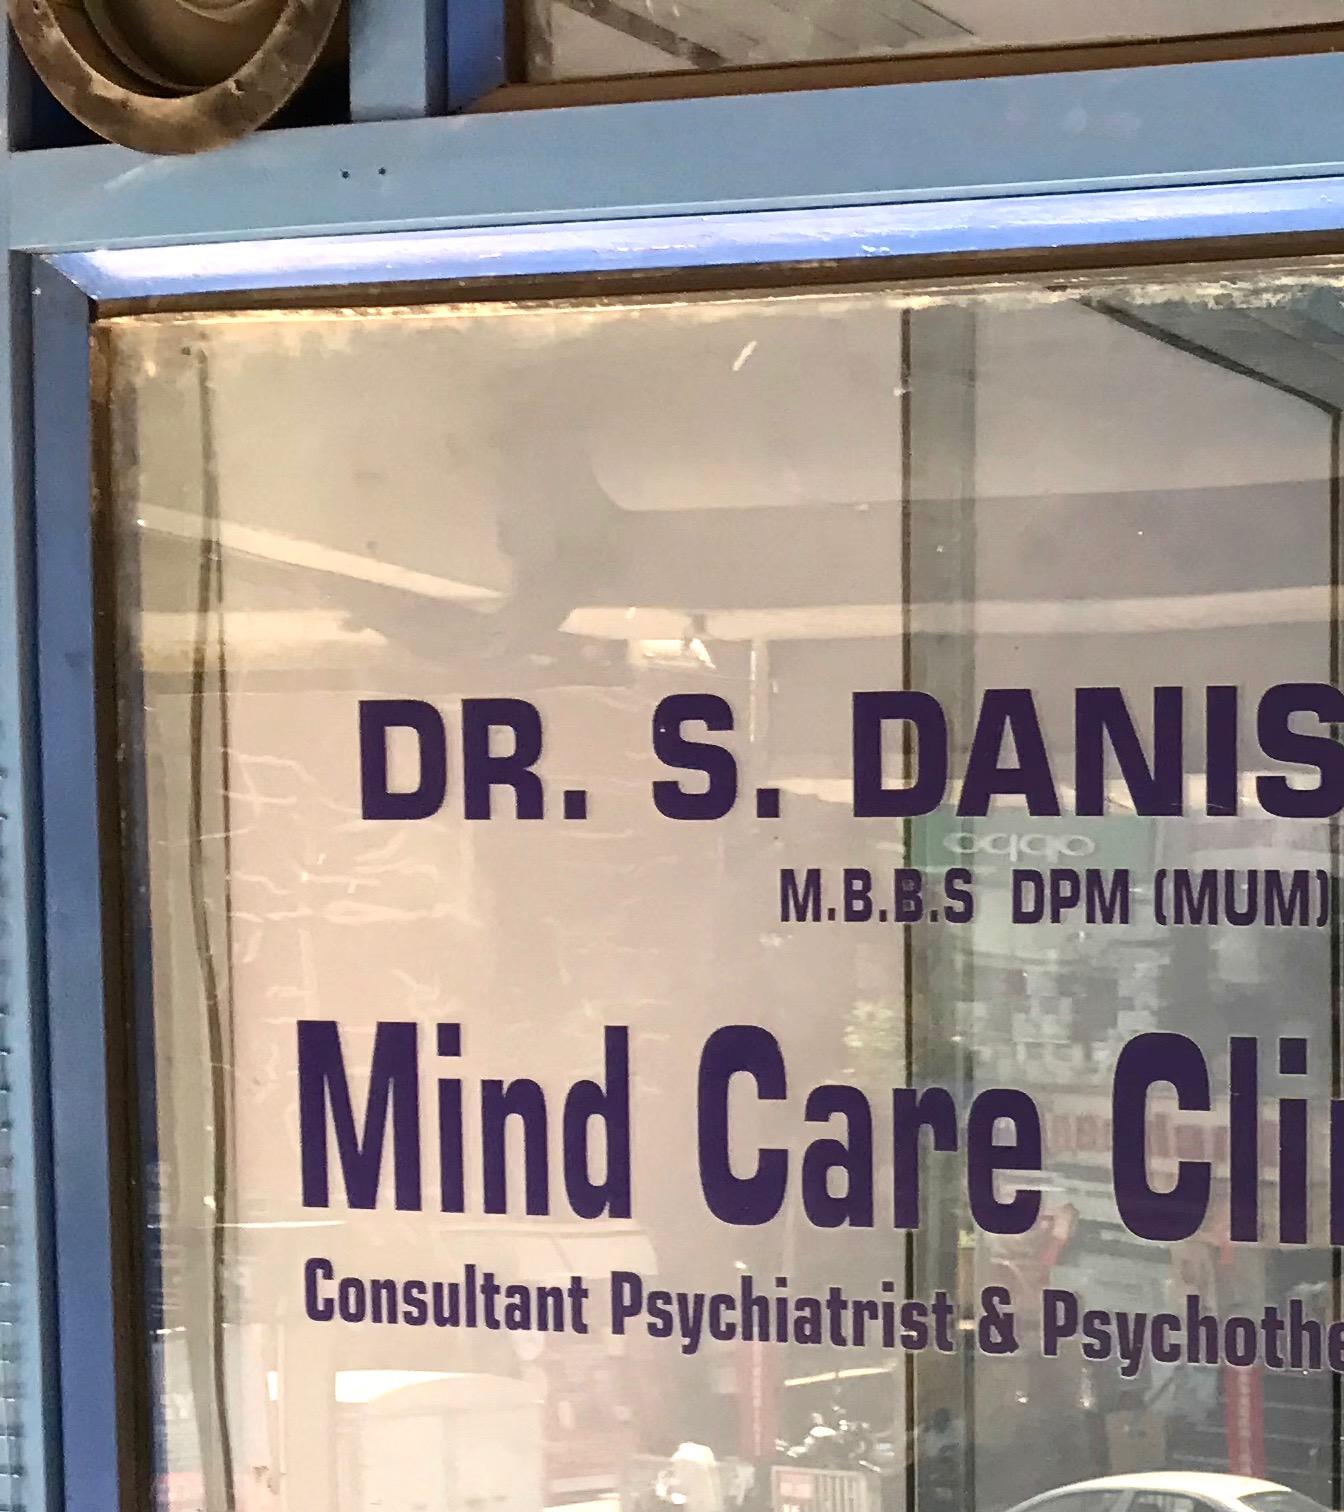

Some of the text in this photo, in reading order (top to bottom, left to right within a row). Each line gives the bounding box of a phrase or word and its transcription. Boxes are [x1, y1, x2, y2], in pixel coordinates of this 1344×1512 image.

[358, 697, 588, 821] DR.
[651, 693, 781, 821] S.
[780, 868, 975, 925] M.B.B.S
[1010, 869, 1132, 925] DPM
[1153, 870, 1332, 928] (MUM)
[296, 1020, 633, 1221] Mind
[697, 1024, 1044, 1236] Care
[304, 1258, 591, 1335] Consultant
[610, 1271, 955, 1356] Psychiatrist
[978, 1287, 1021, 1355] &
